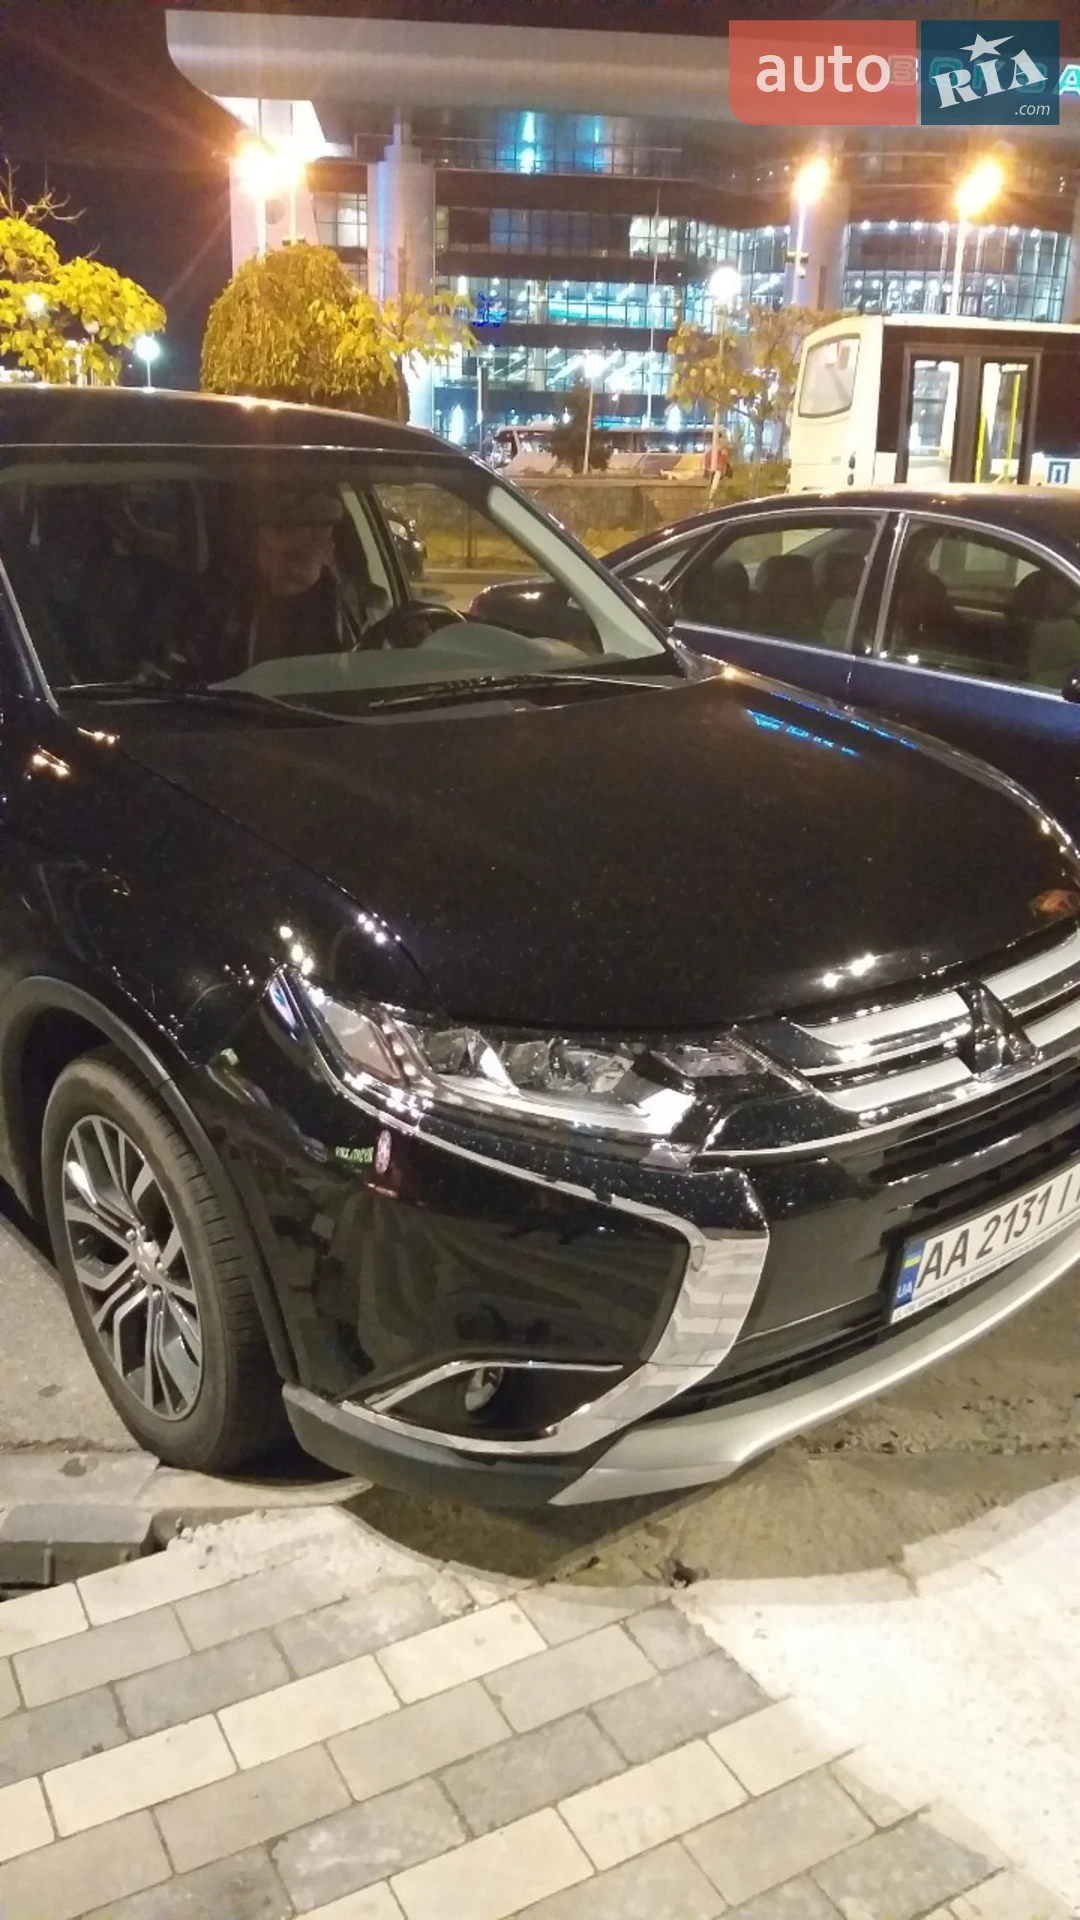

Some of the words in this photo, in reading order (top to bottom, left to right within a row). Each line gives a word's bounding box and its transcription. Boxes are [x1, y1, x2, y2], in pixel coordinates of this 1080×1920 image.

[916, 1228, 970, 1289] AA
[975, 1185, 1053, 1260] 2131
[896, 1284, 913, 1299] UA
